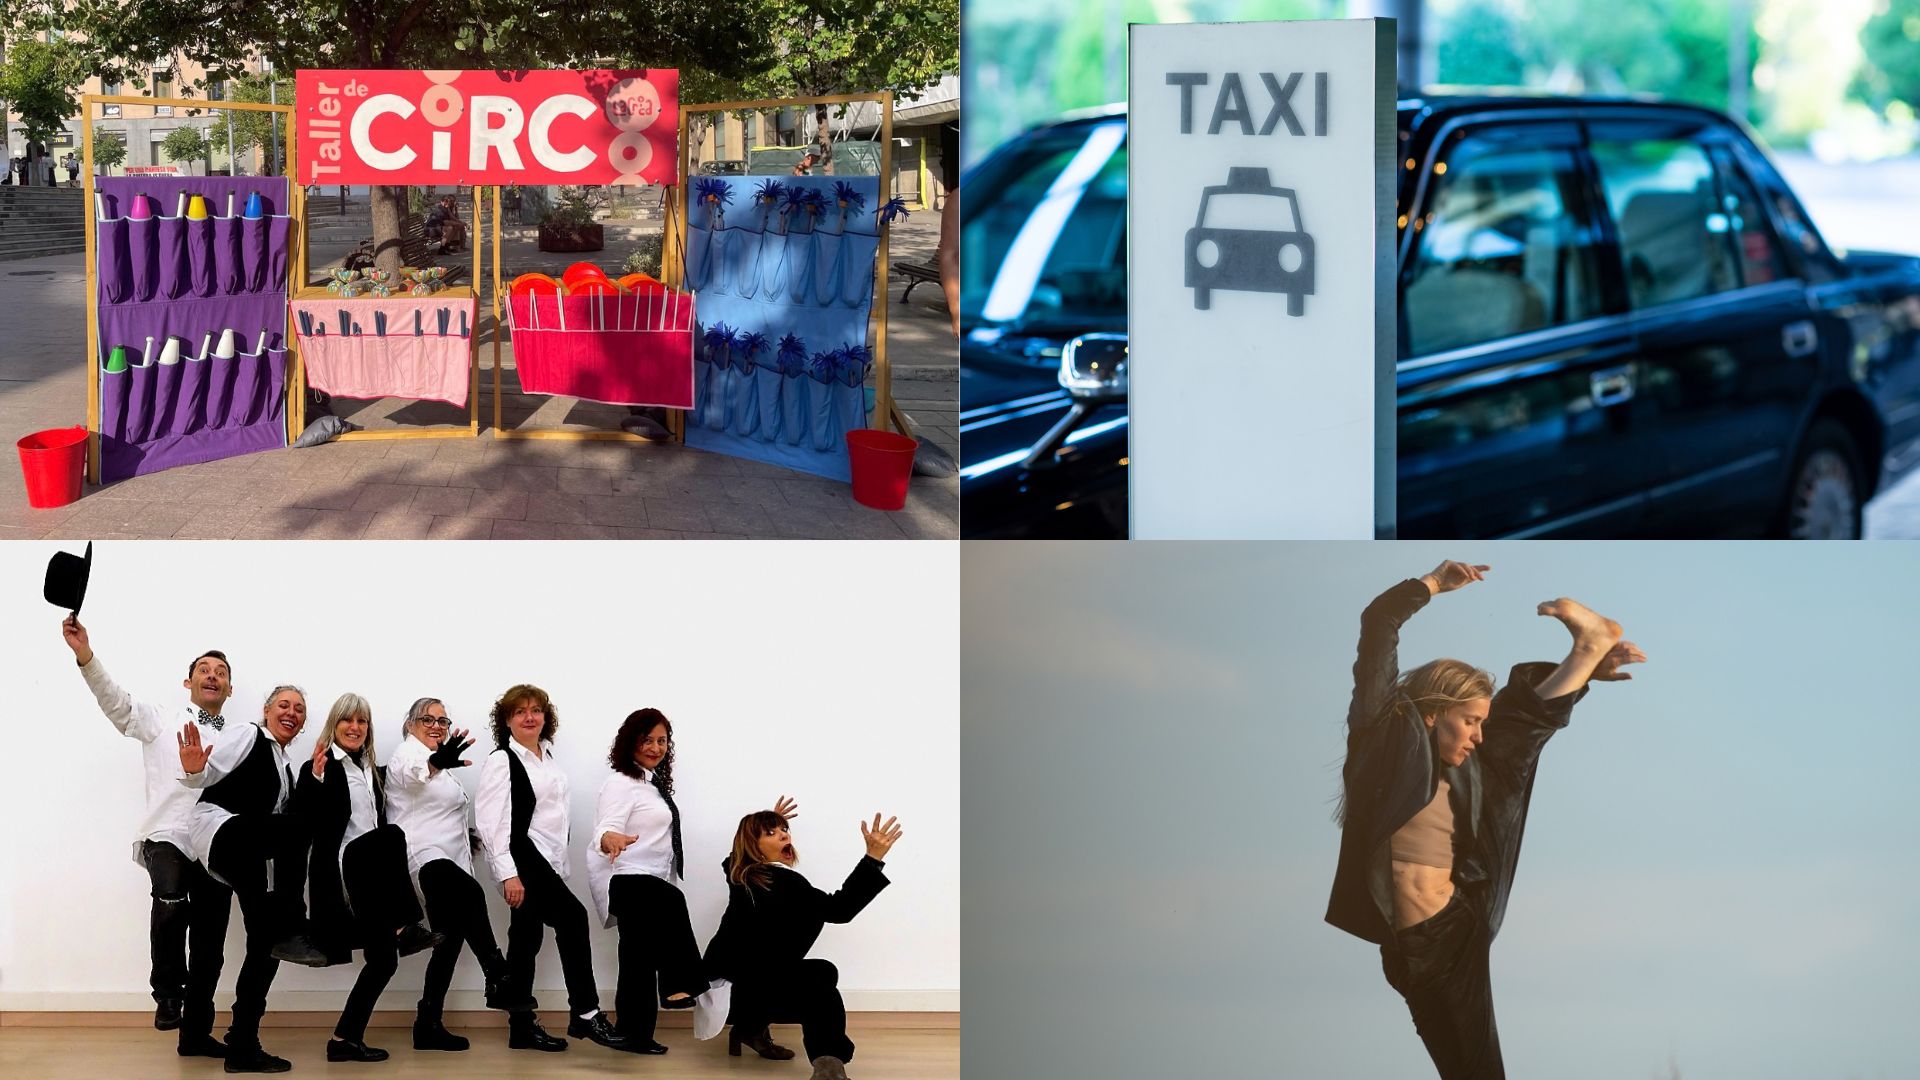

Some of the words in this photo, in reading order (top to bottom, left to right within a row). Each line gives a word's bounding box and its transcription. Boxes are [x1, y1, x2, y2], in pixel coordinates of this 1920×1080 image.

[343, 79, 369, 97] de
[1165, 71, 1328, 137] TAXI
[309, 82, 342, 178] Taller
